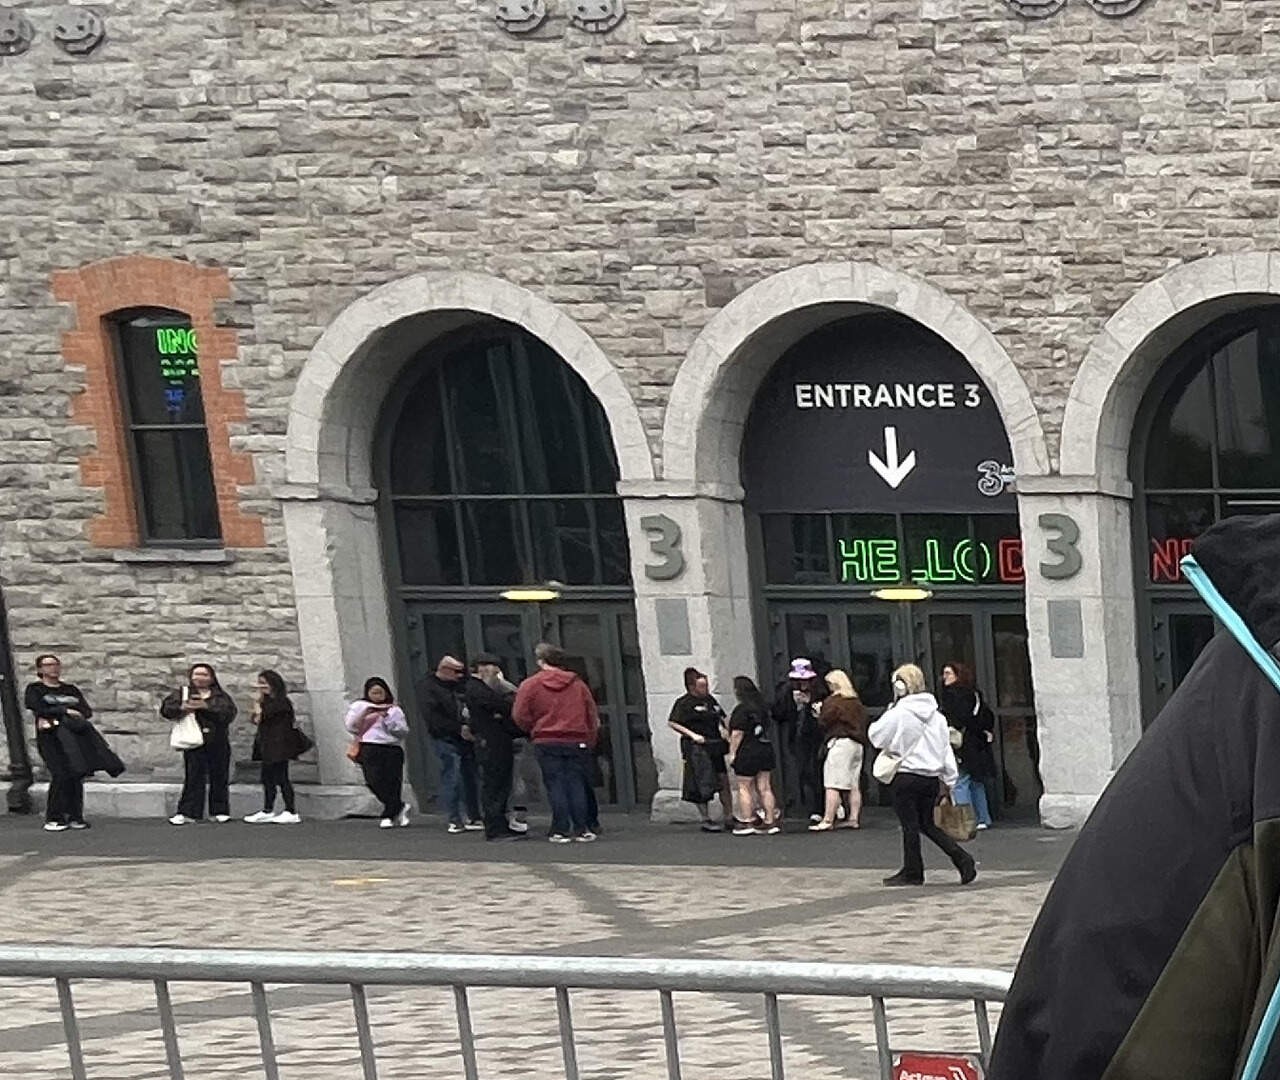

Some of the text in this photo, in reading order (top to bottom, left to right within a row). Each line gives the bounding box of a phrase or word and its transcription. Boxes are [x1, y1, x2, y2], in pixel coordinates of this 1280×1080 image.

[795, 384, 981, 408] ENTRANCE 3
[640, 513, 686, 580] 3
[1038, 513, 1083, 580] 3
